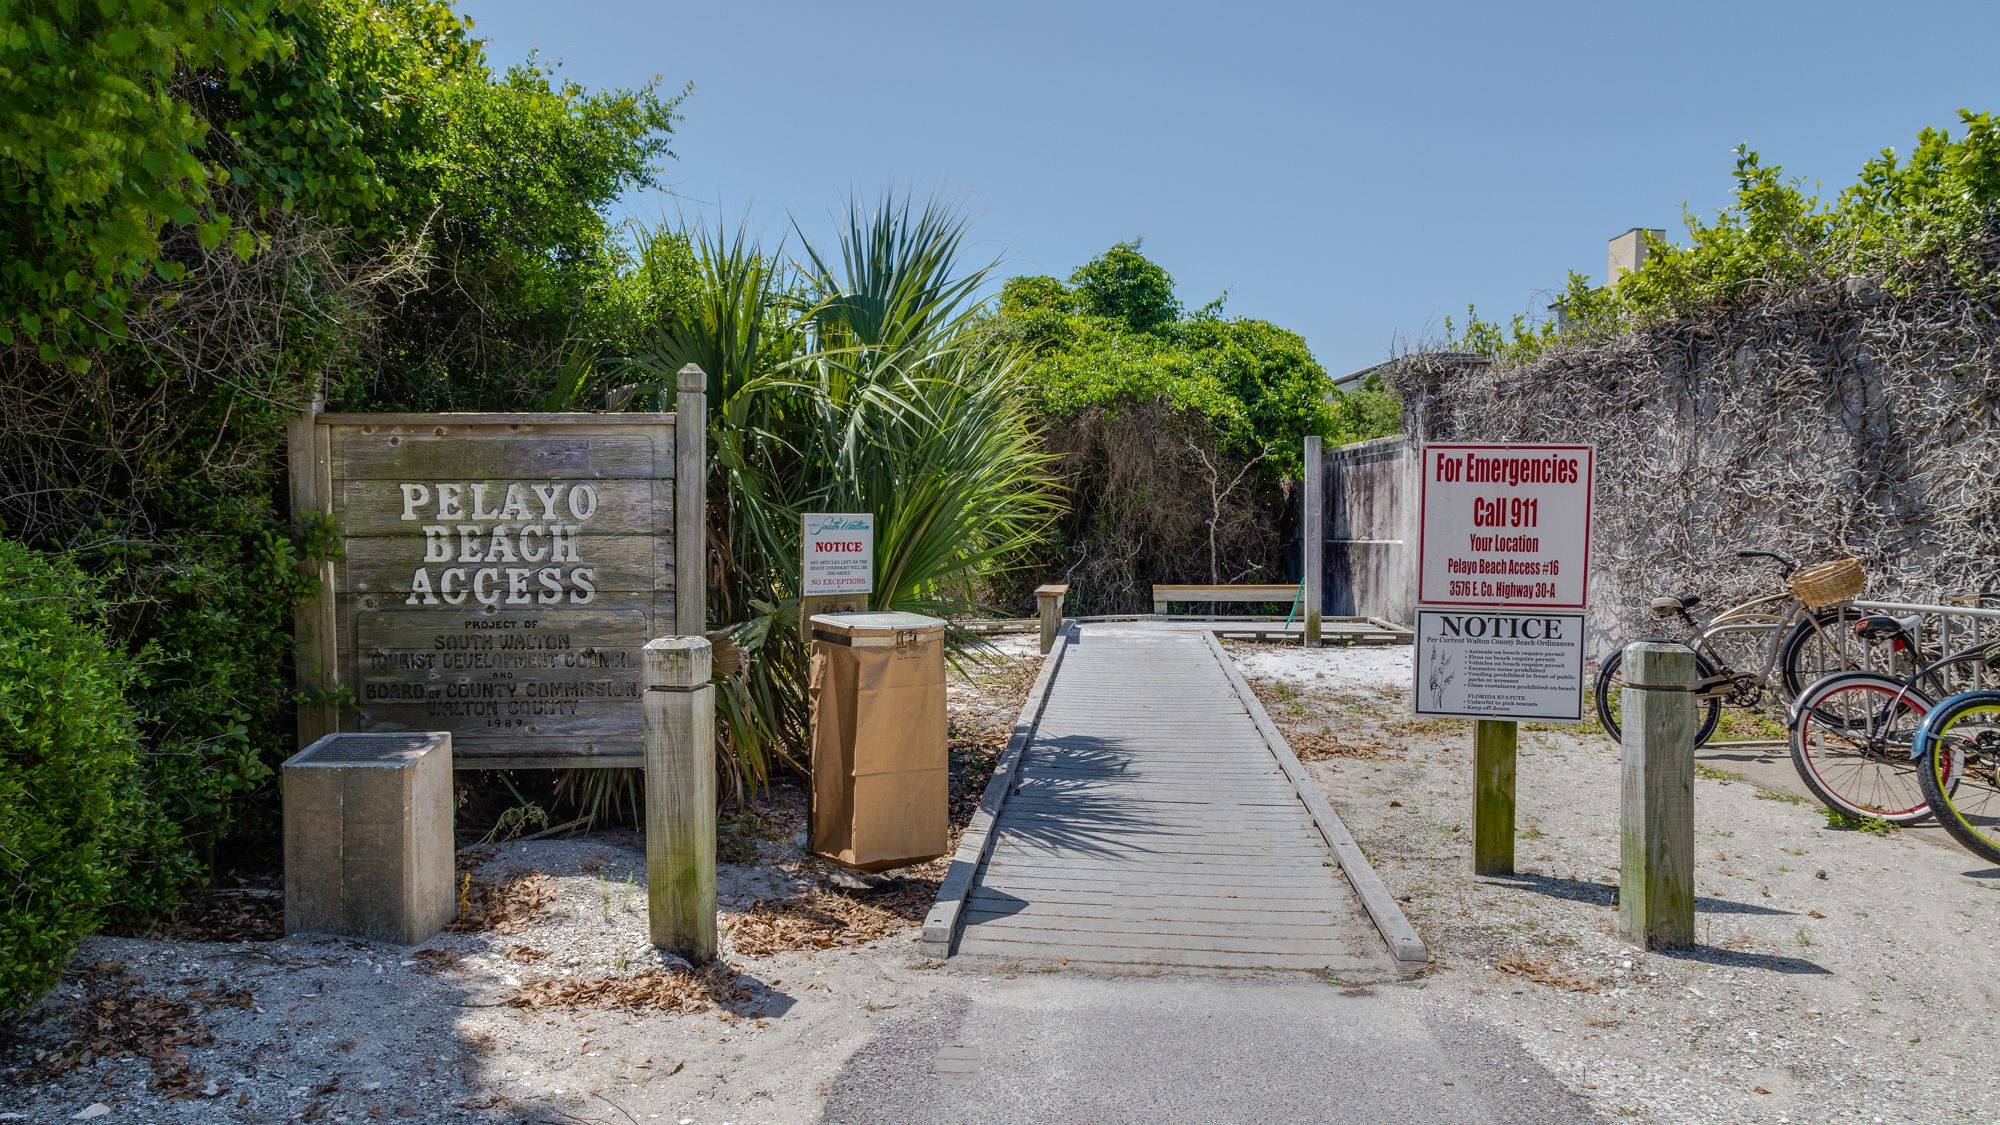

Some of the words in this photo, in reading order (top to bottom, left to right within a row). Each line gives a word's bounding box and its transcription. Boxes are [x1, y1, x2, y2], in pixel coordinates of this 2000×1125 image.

[1436, 453, 1462, 482] For
[1466, 453, 1578, 486] Emergencies
[400, 482, 598, 520] PELAYO
[1474, 496, 1506, 527] Call
[1510, 498, 1538, 528] 911
[810, 516, 840, 535] South
[840, 516, 870, 530] Walton
[422, 524, 580, 562] BEACH
[815, 542, 863, 552] NOTICE
[1470, 534, 1492, 552] Your
[1494, 534, 1538, 552] Location
[1448, 558, 1478, 575] Pelayo
[1480, 558, 1506, 574] Beach
[1508, 560, 1540, 575] Access
[1542, 560, 1559, 576] #16
[406, 567, 596, 605] ACCESS
[1450, 580, 1470, 596] 3576
[1472, 581, 1479, 596] E.
[1481, 581, 1494, 596] Co.
[1496, 582, 1534, 599] Highway
[1535, 582, 1556, 598] 30-A
[464, 620, 517, 630] PROJECT
[524, 620, 538, 628] OF
[1440, 616, 1563, 640] NOTICE
[434, 634, 494, 650] SOUTH
[500, 634, 570, 650] WALTON
[368, 652, 436, 669] TOURIST
[443, 652, 558, 668] DEVELOPMENT
[564, 652, 636, 668] COUNCIL
[366, 683, 424, 698] BOARD
[446, 682, 517, 698] COUNTY
[526, 682, 642, 698] COMMISSION,
[428, 701, 498, 716] WALTON
[508, 700, 578, 715] COUNTY
[487, 719, 522, 728] 1989
